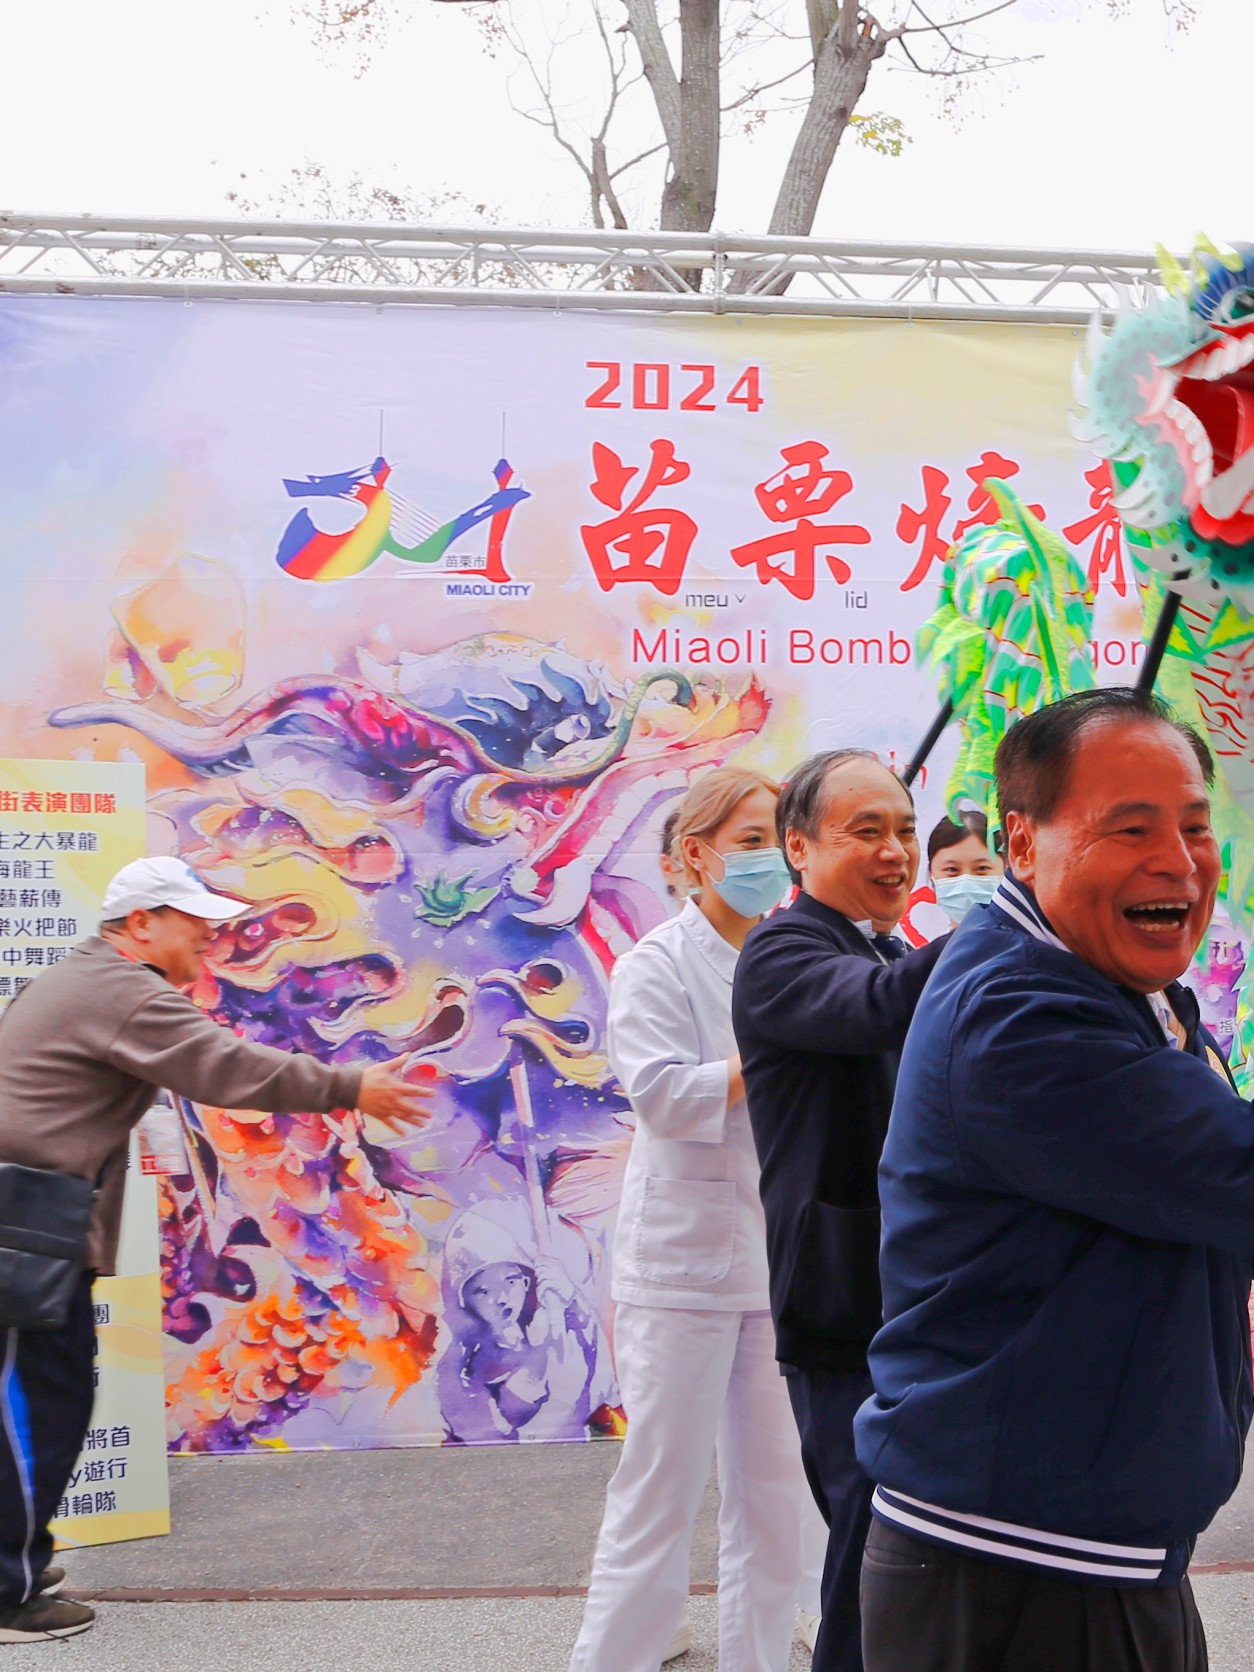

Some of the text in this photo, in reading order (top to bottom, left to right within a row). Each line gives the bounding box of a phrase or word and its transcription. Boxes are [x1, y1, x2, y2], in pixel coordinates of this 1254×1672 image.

[585, 361, 764, 411] 2024
[445, 555, 486, 568] 苗栗市
[447, 585, 531, 596] MIAOLI CITY
[844, 591, 868, 609] lid
[632, 628, 767, 664] Miaoli
[789, 629, 911, 664] Bomb
